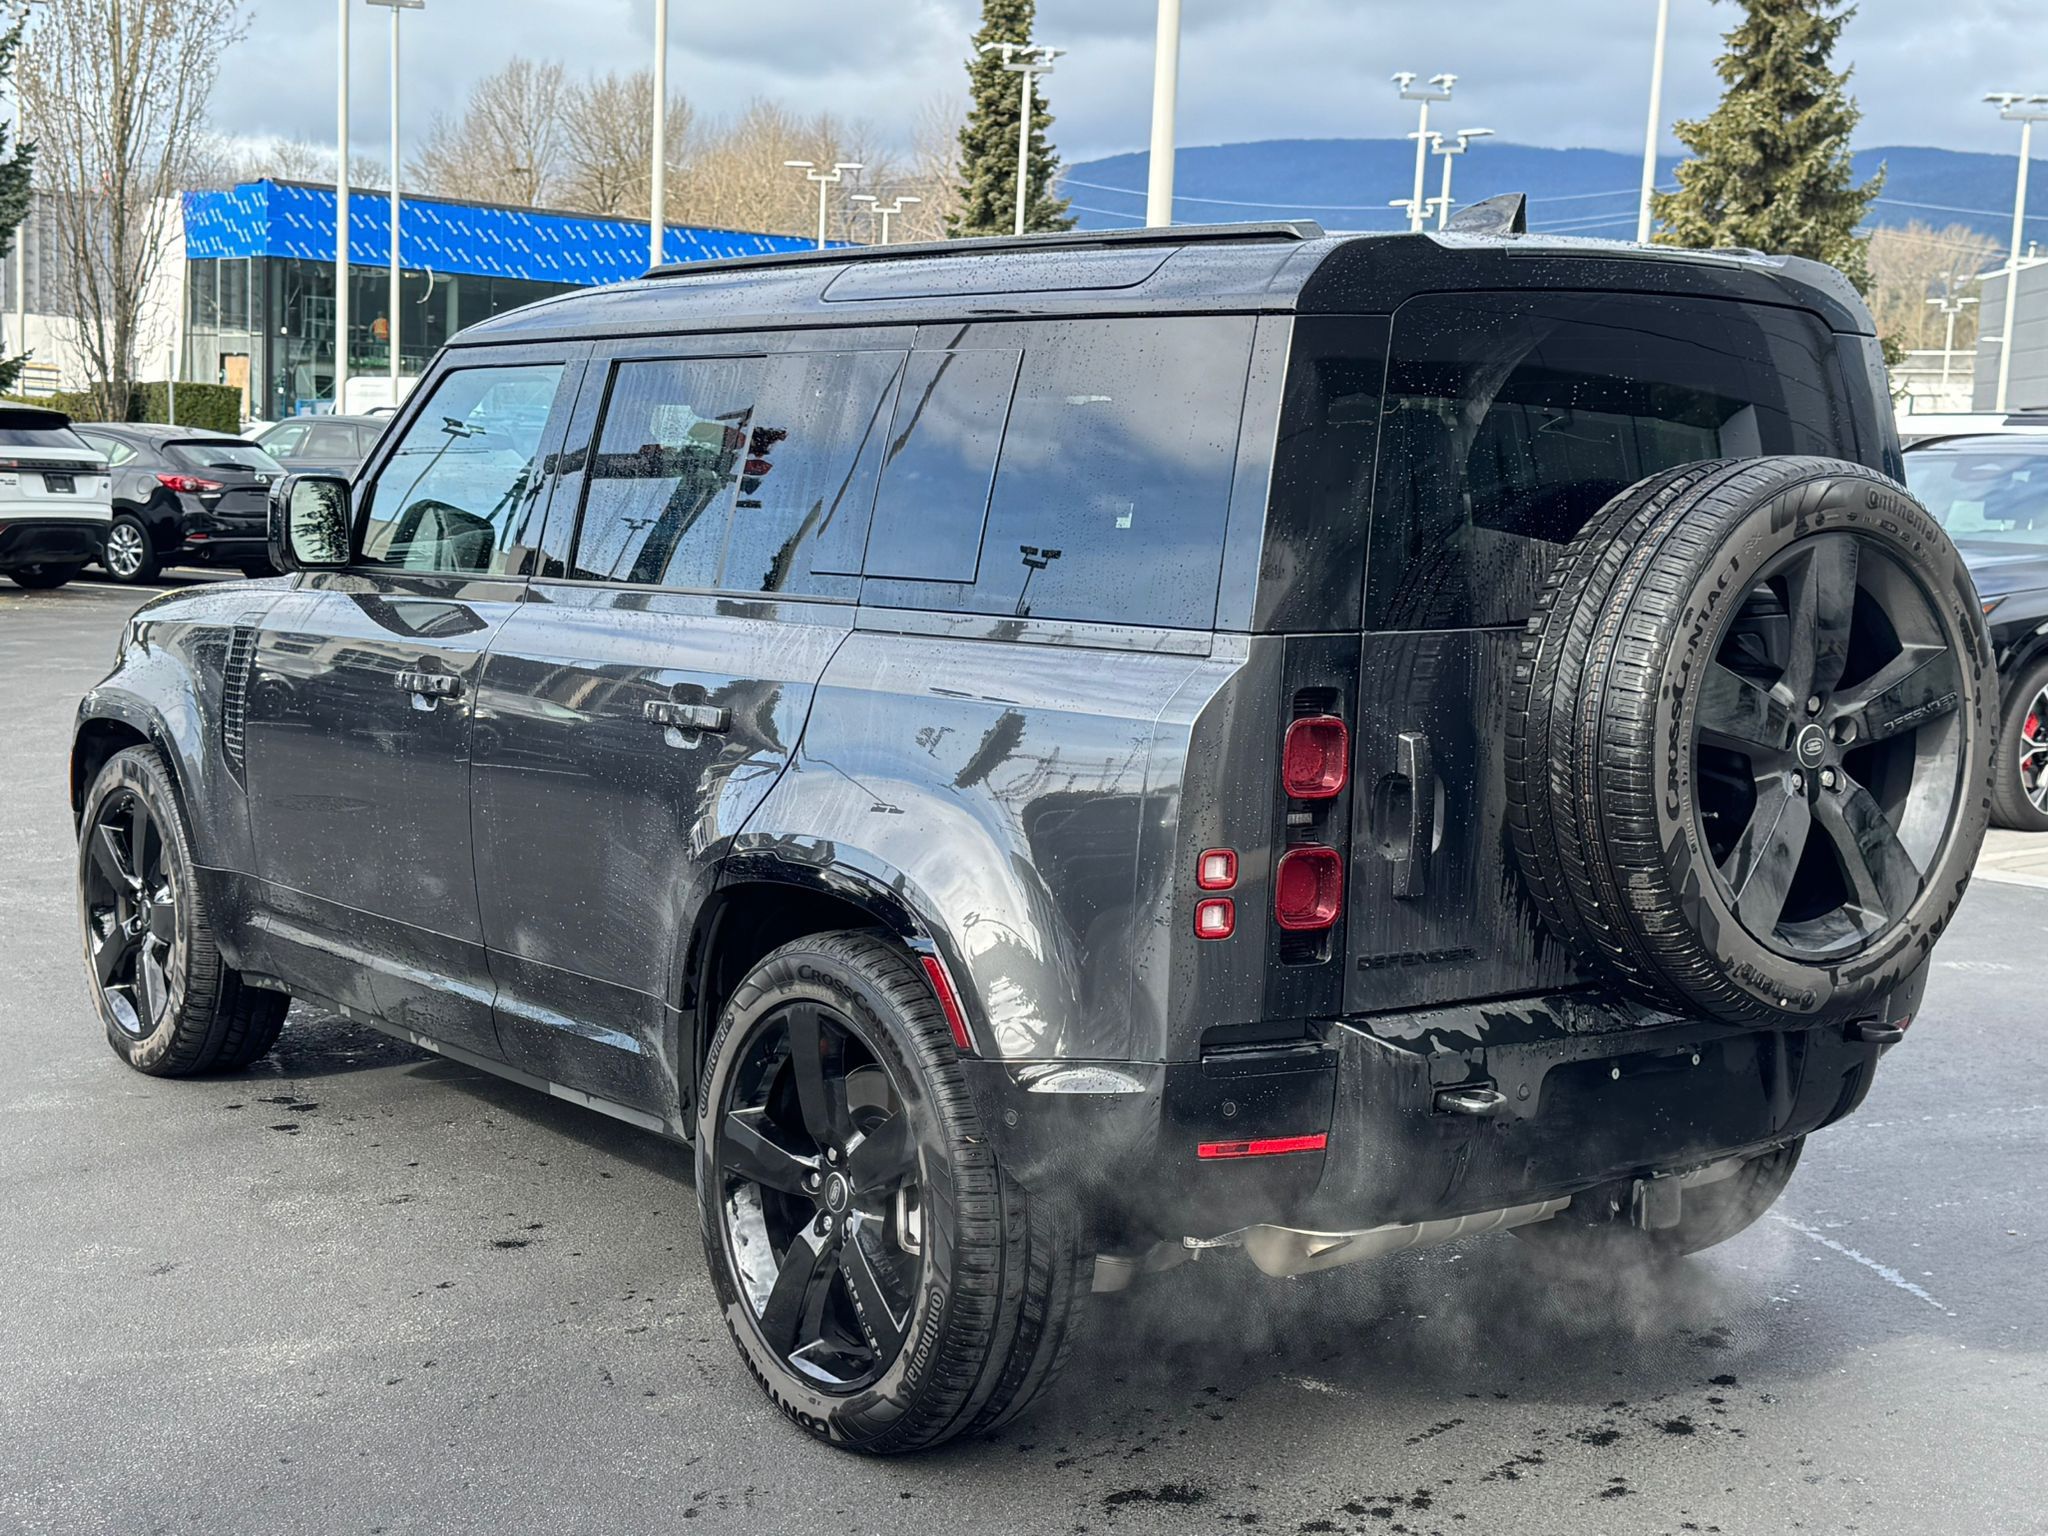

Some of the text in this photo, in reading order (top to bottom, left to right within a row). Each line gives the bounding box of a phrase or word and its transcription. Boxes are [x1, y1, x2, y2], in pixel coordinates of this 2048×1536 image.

[1865, 486, 1939, 545] Continental
[1356, 947, 1477, 971] DEFENDER
[904, 1286, 946, 1391] Continental
